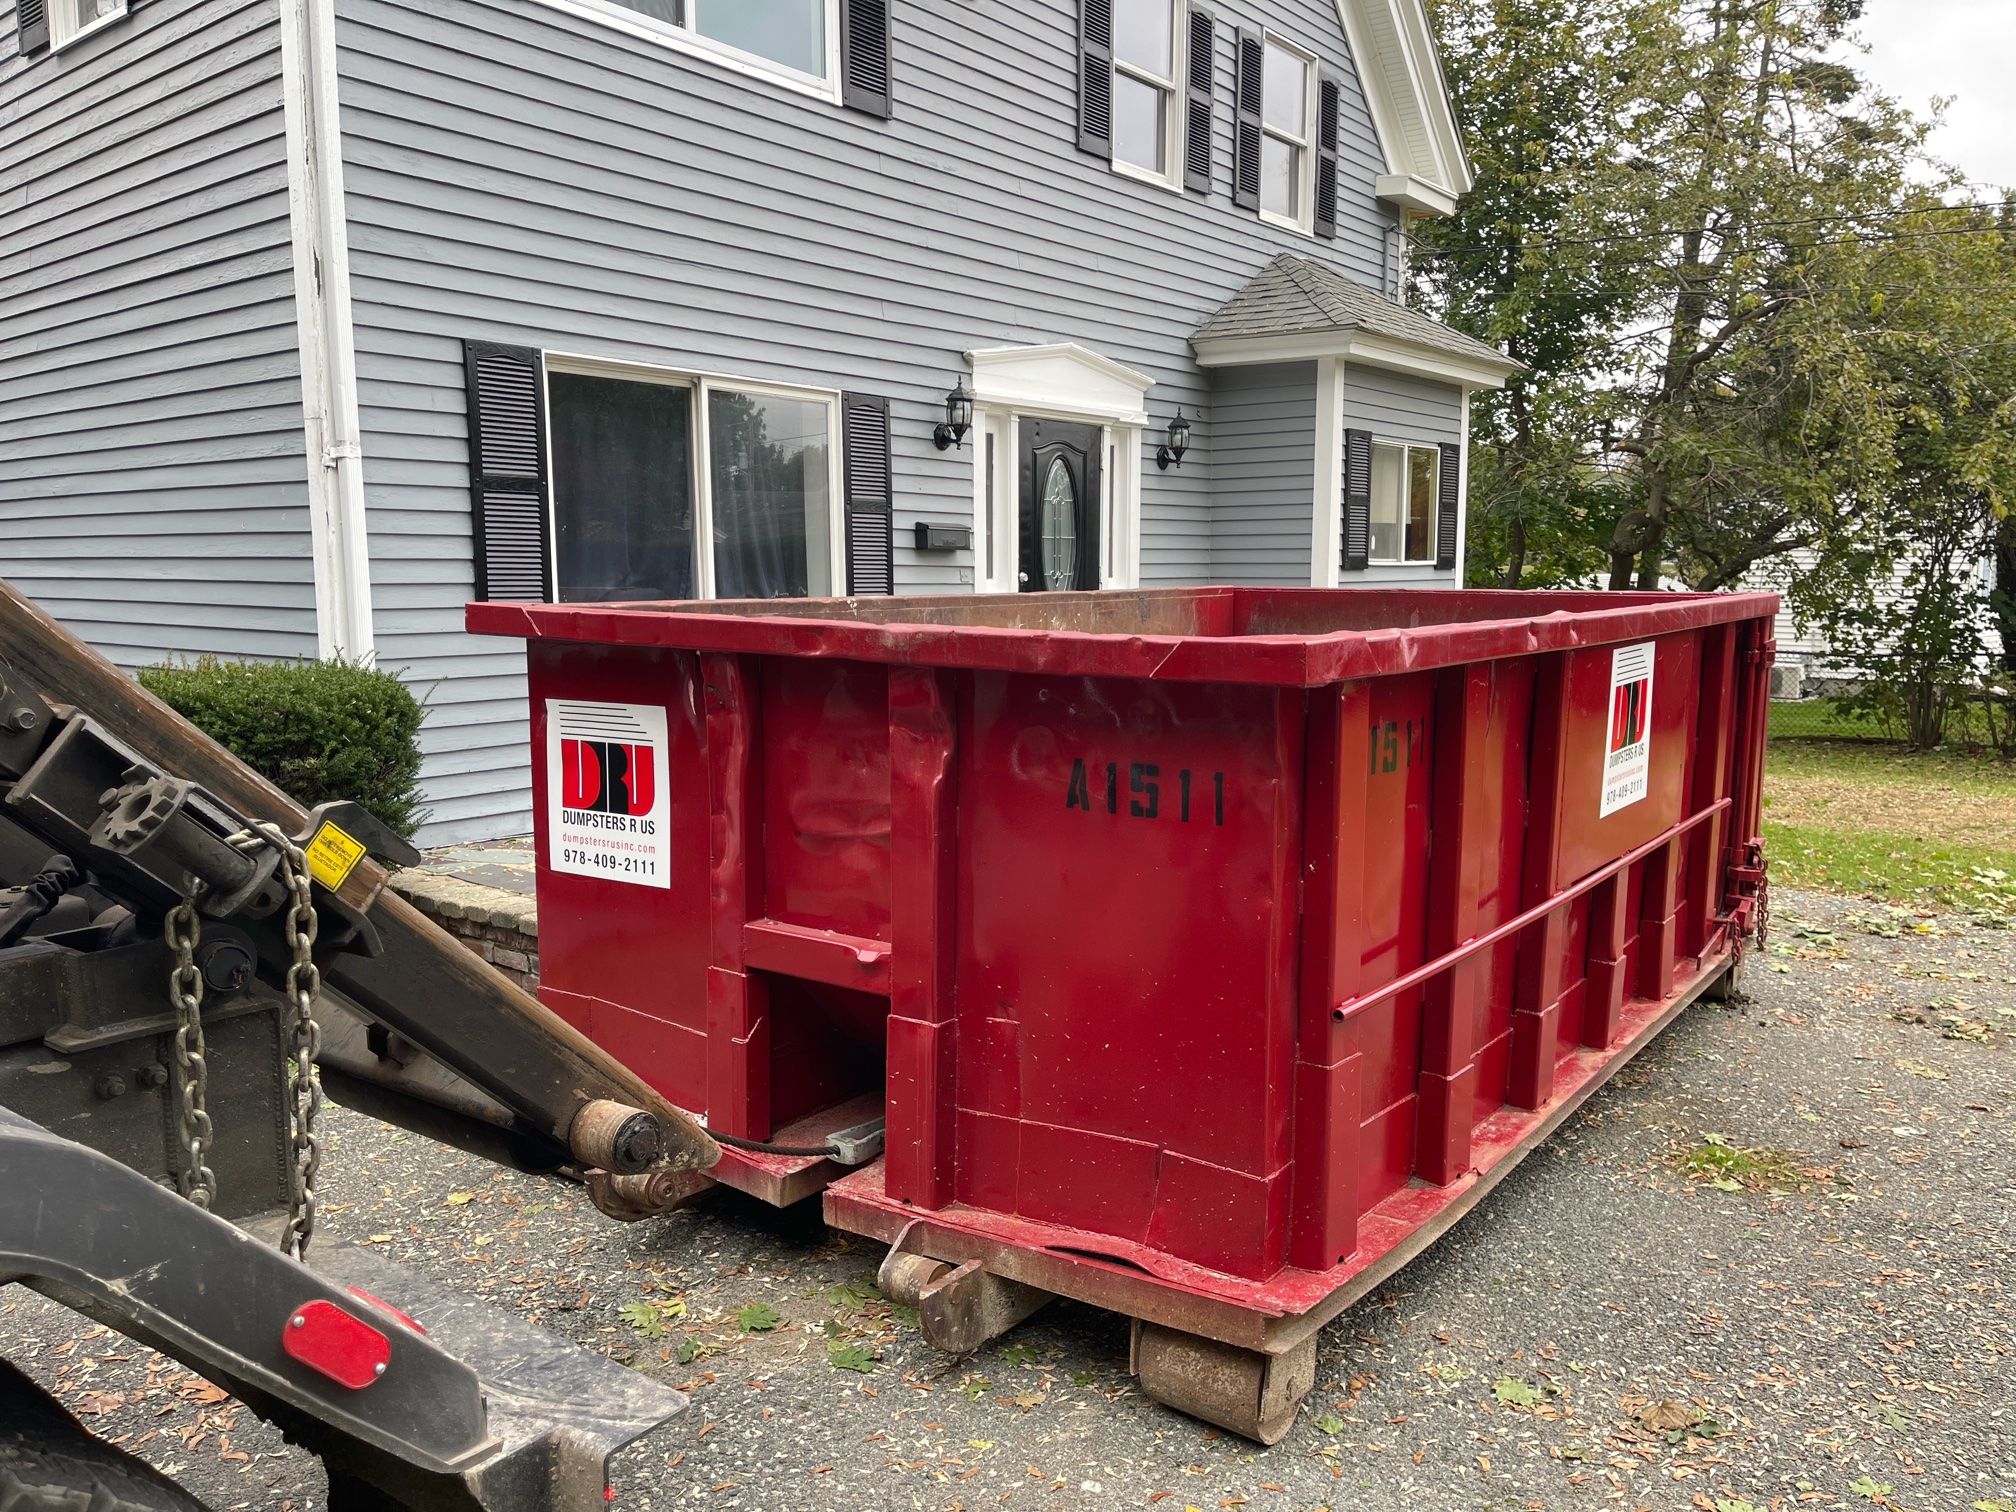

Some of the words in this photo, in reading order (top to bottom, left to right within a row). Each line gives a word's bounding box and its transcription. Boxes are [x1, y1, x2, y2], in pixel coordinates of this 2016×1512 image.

[1610, 677, 1649, 754] DRU
[1370, 716, 1425, 775] 1511
[561, 738, 655, 817] DRU
[1066, 758, 1223, 826] A1511
[1607, 778, 1643, 805] 978-409-2111
[562, 809, 626, 831] DUMPSTERS
[629, 818, 637, 833] R
[640, 819, 655, 835] US
[562, 832, 656, 854] dumpstersrusinc.com
[564, 848, 655, 875] 978-409-2111
